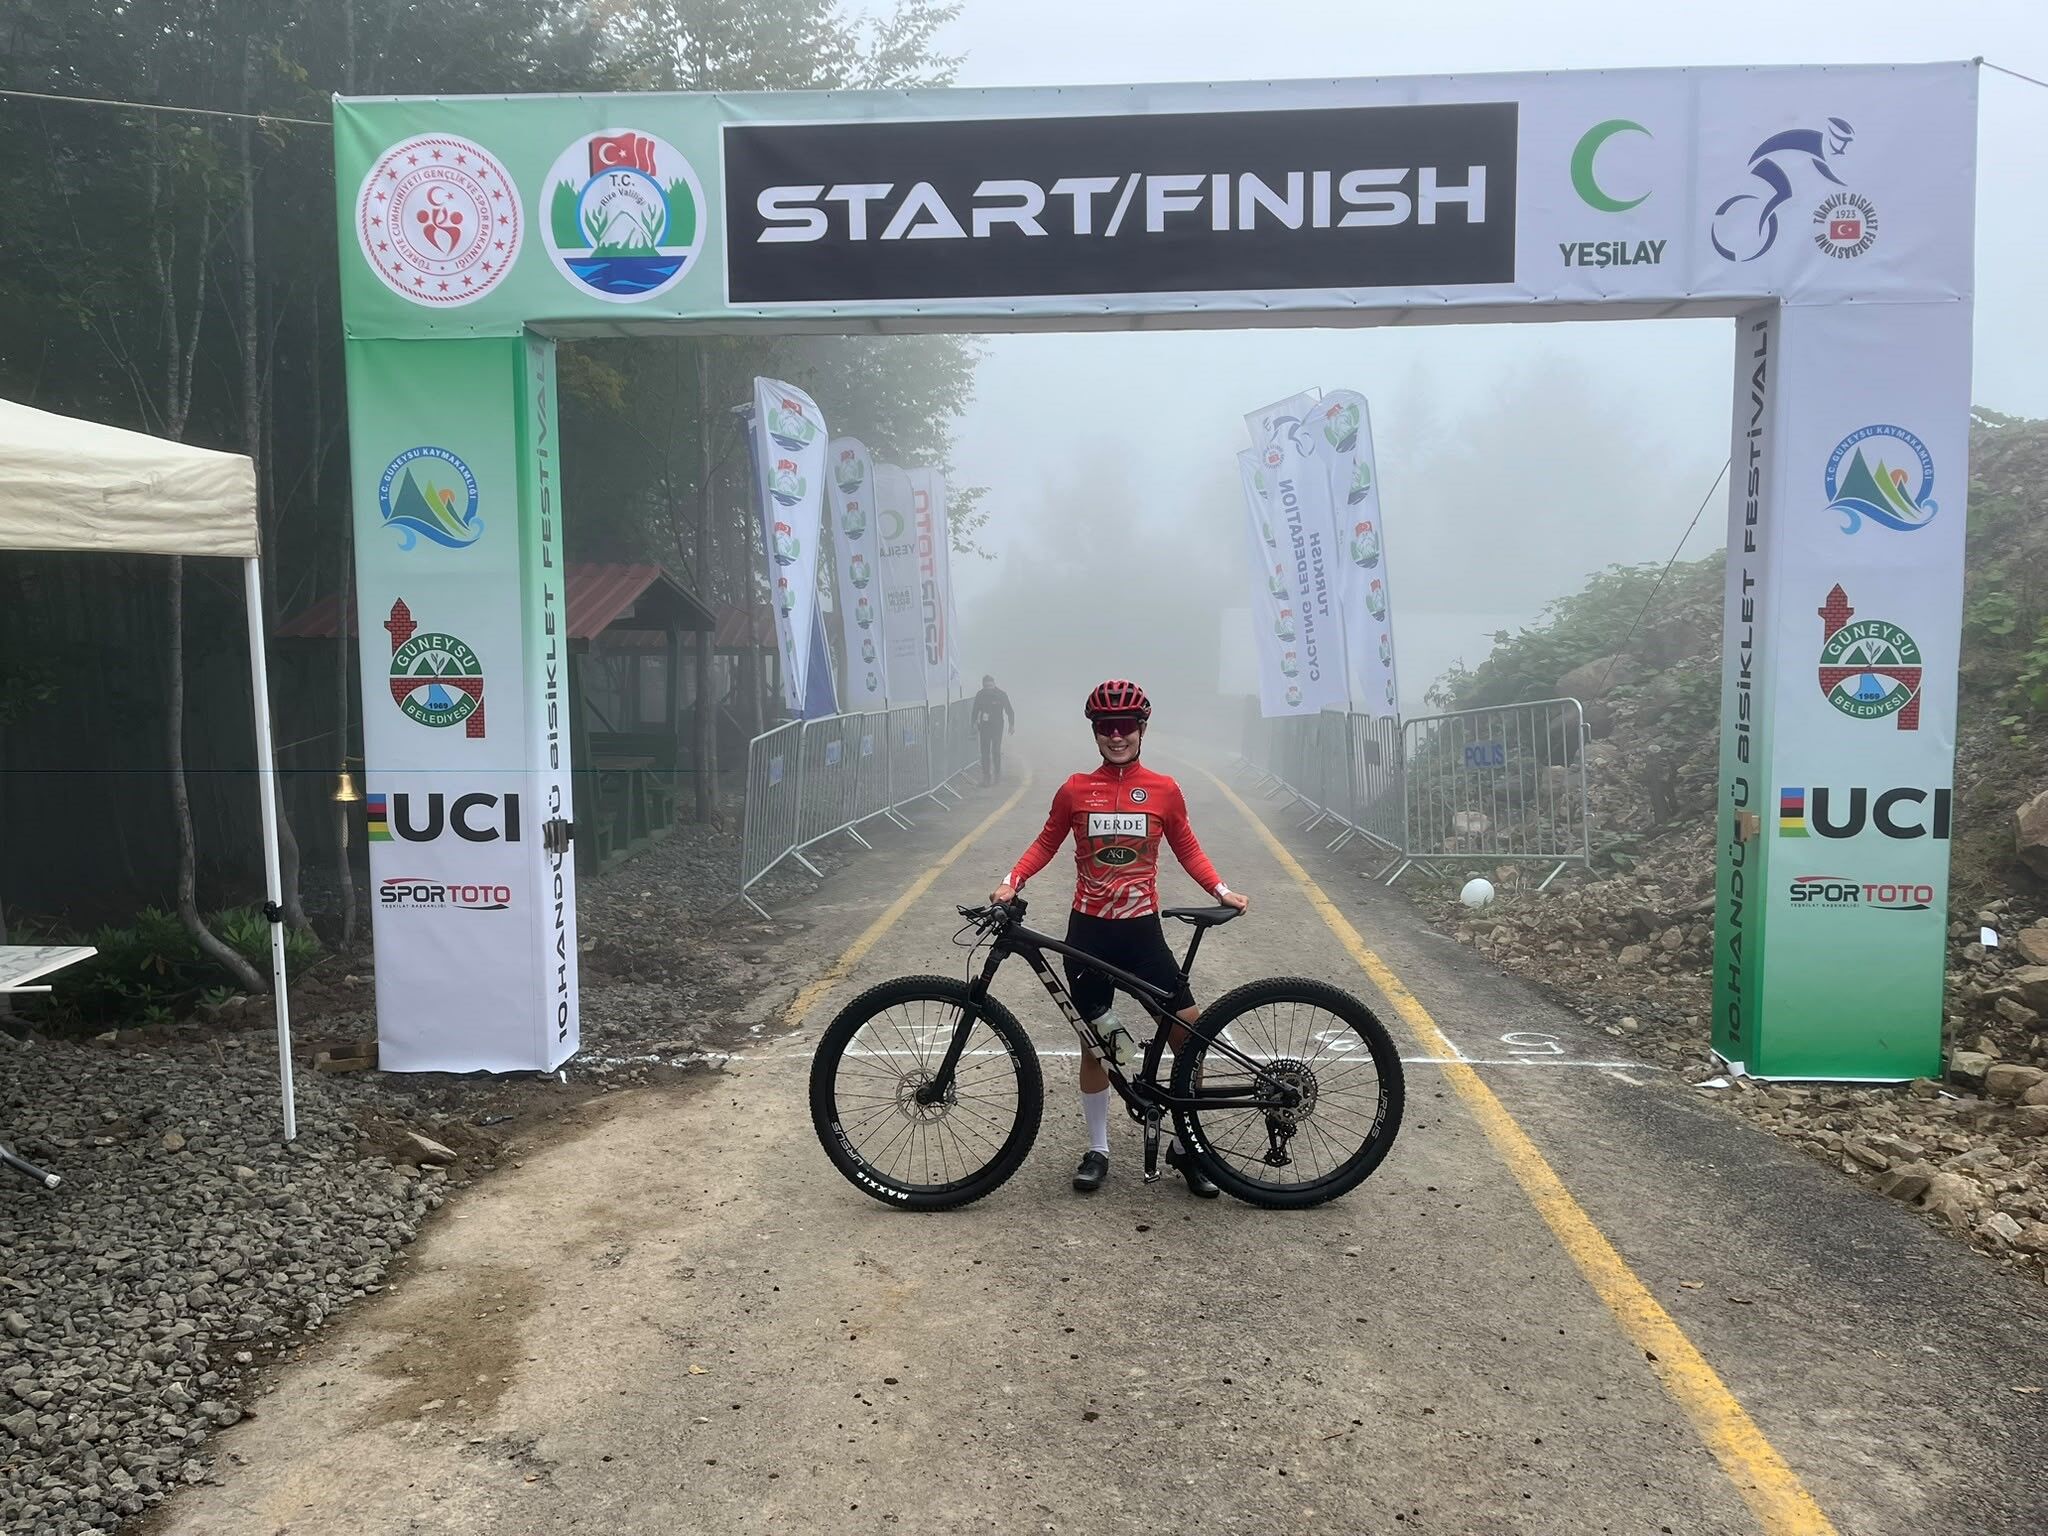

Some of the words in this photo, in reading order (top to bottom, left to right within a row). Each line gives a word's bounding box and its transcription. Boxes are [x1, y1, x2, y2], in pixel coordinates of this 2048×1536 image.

[600, 191, 617, 207] Rize
[610, 174, 635, 187] T.C.
[466, 181, 478, 195] VE
[474, 194, 489, 221] SPOR
[756, 165, 1487, 243] START/FINISH
[1813, 192, 1848, 224] TÜRKİYE
[1836, 209, 1857, 219] 1923
[1558, 239, 1667, 269] YEŞİLAY
[1814, 231, 1876, 259] FEDERASYONU
[1744, 319, 1768, 553] FESTİVALİ
[532, 345, 553, 569] FESTİVALİ
[397, 636, 476, 667] GÜNEYSU
[1828, 623, 1915, 656] GÜNEYSU
[544, 582, 559, 770] BİSİKLET
[1735, 568, 1755, 764] BİSİKLET
[407, 703, 471, 724] BELEDİYESİ
[1834, 694, 1905, 715] BELEDİYESİ
[393, 792, 521, 842] UCI
[1093, 819, 1143, 830] VERDE
[1811, 787, 1951, 839] UCI
[549, 784, 568, 1044] 10.HANDÜÜ
[1728, 775, 1749, 1043] 10.HANDÜÜ
[1038, 960, 1119, 1075] TREK
[1371, 1087, 1388, 1140] URSUS
[831, 1121, 864, 1166] URSUS
[856, 1171, 909, 1200] MAXXIS
